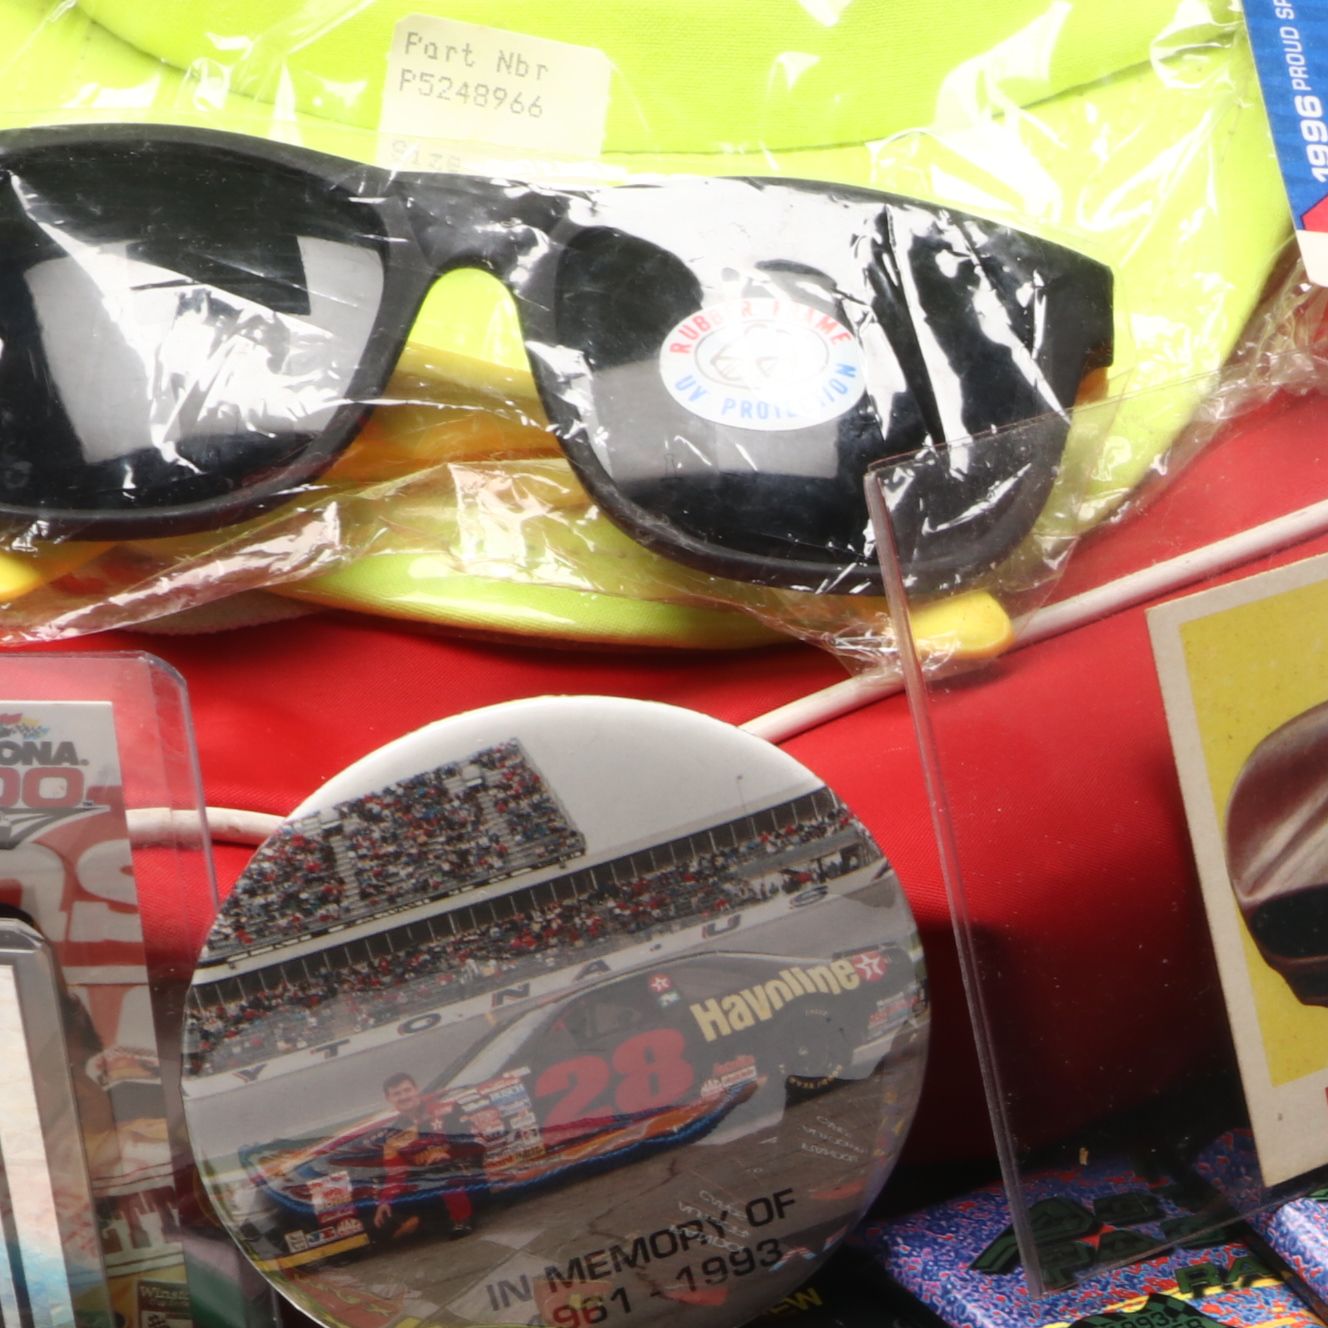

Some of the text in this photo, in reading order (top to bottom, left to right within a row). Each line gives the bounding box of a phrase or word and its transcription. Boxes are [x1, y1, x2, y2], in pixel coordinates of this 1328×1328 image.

[404, 31, 549, 81] Part Nbr
[1280, 26, 1311, 91] PROUD
[399, 68, 544, 119] P5248966
[689, 957, 861, 1043] Havoline
[534, 1027, 695, 1146] 28
[486, 1274, 533, 1312] IN
[544, 1211, 727, 1294] MEMORY
[744, 1187, 799, 1228] OF
[675, 1238, 784, 1294] 1993
